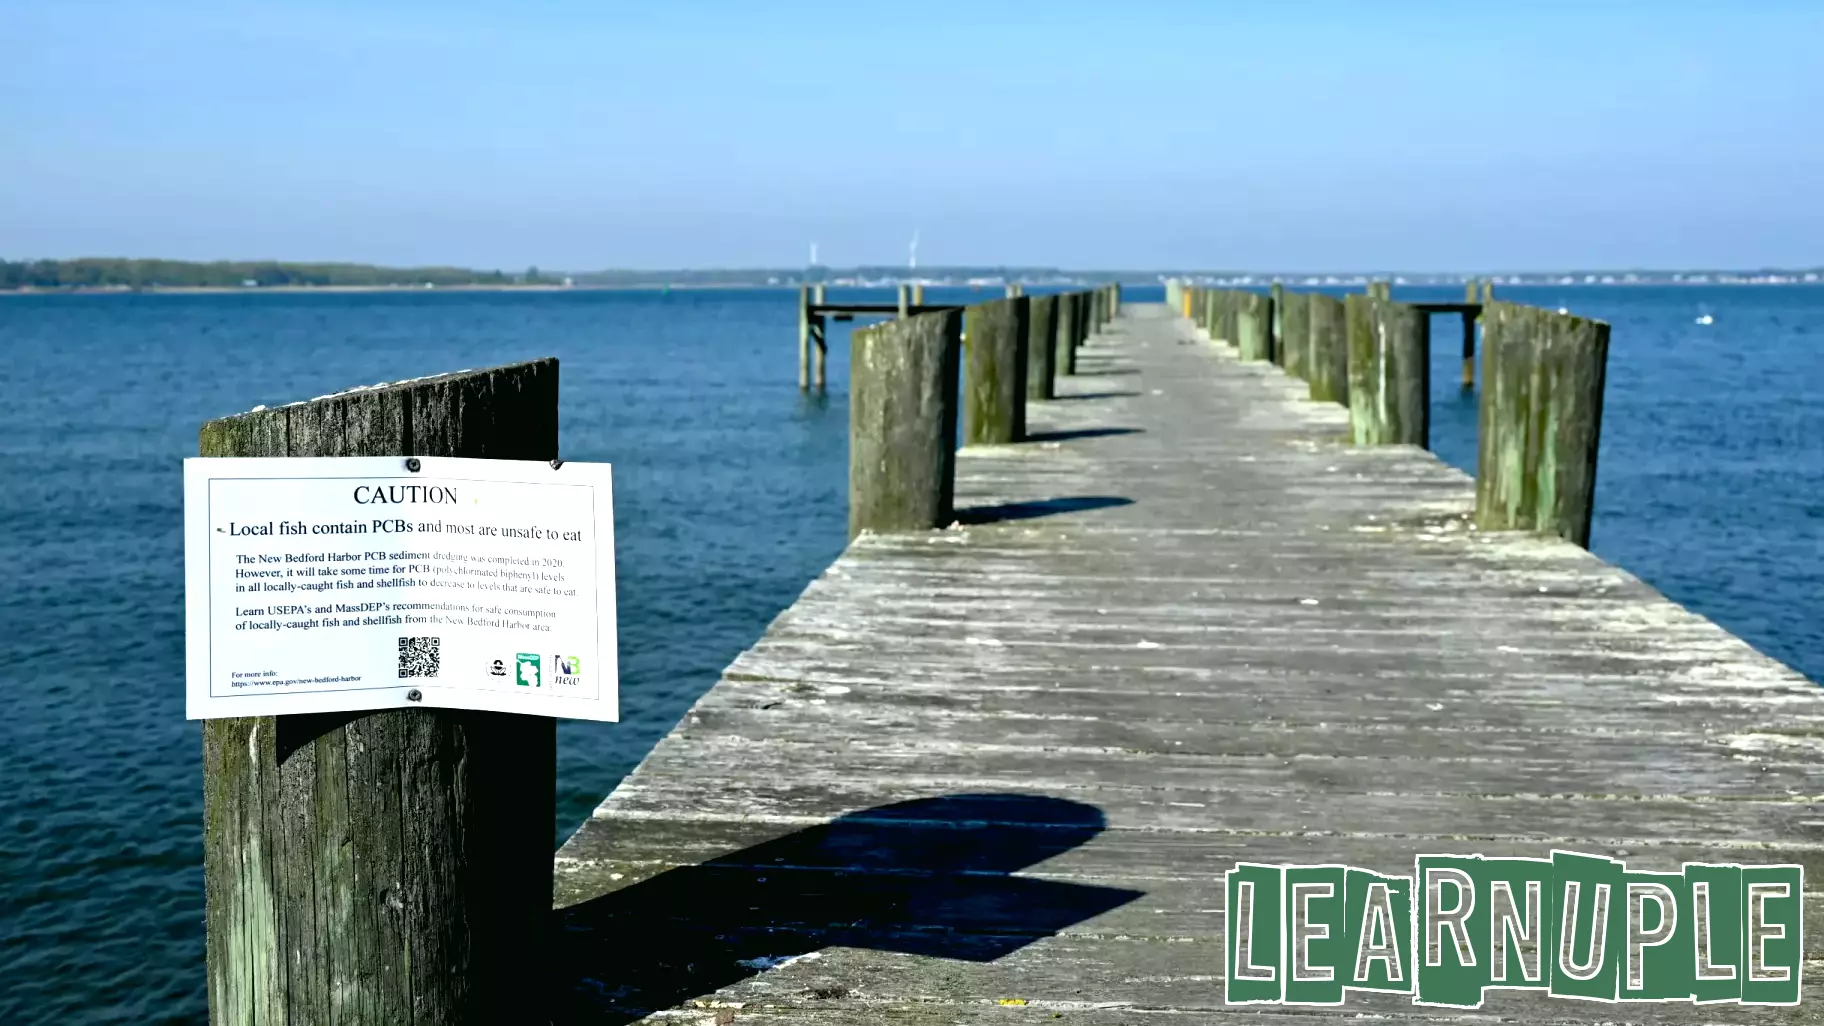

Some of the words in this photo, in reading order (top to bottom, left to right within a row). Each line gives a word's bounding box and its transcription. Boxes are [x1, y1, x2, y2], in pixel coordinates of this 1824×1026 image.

[354, 486, 456, 504] CAUTION
[230, 522, 273, 536] Local
[279, 521, 307, 535] fish
[312, 520, 367, 534] contain
[372, 519, 413, 533] PCBs
[418, 520, 441, 532] and
[446, 525, 474, 534] most
[479, 526, 497, 536] are
[501, 526, 542, 539] unsafe
[547, 529, 558, 540] to
[563, 531, 581, 541] eat
[236, 555, 255, 564] The
[258, 554, 282, 563] New
[285, 553, 324, 563] Bedford
[328, 552, 362, 561] Harbor
[365, 552, 386, 560] PCB
[389, 551, 430, 560] sediment
[433, 551, 467, 563] dredging
[488, 557, 529, 565] completed
[543, 558, 564, 567] 2020.
[236, 569, 283, 578] However,
[287, 568, 293, 576] it
[296, 567, 314, 576] will
[318, 567, 338, 576] take
[369, 566, 389, 574] time
[392, 565, 406, 573] for
[409, 565, 430, 573] PCB
[433, 566, 497, 577] (polychlorinated
[501, 569, 539, 582] biphenyl)
[542, 573, 564, 581] levels
[236, 583, 245, 592] in
[248, 582, 260, 592] all
[264, 581, 333, 593] locally-caught
[336, 580, 354, 589] fish
[357, 580, 374, 588] and
[376, 578, 415, 588] shellfish
[430, 579, 464, 588] decrease
[478, 581, 500, 590] levels
[503, 583, 517, 592] that
[535, 586, 551, 594] safe
[236, 607, 264, 616] Learn
[268, 605, 312, 615] USEPA's
[315, 604, 332, 613] and
[336, 602, 390, 612] MassDEP's
[392, 602, 469, 612] recommendations
[472, 604, 483, 612] for
[486, 606, 501, 614] safe
[504, 609, 555, 619] consumption
[235, 621, 246, 630] of
[250, 619, 319, 631] locally-caught
[322, 618, 339, 627] fish
[343, 617, 360, 626] and
[363, 615, 402, 625] shellfish
[405, 615, 426, 623] from
[430, 615, 443, 623] the
[446, 616, 463, 624] New
[468, 617, 499, 627] Bedford
[503, 620, 530, 629] Harbor
